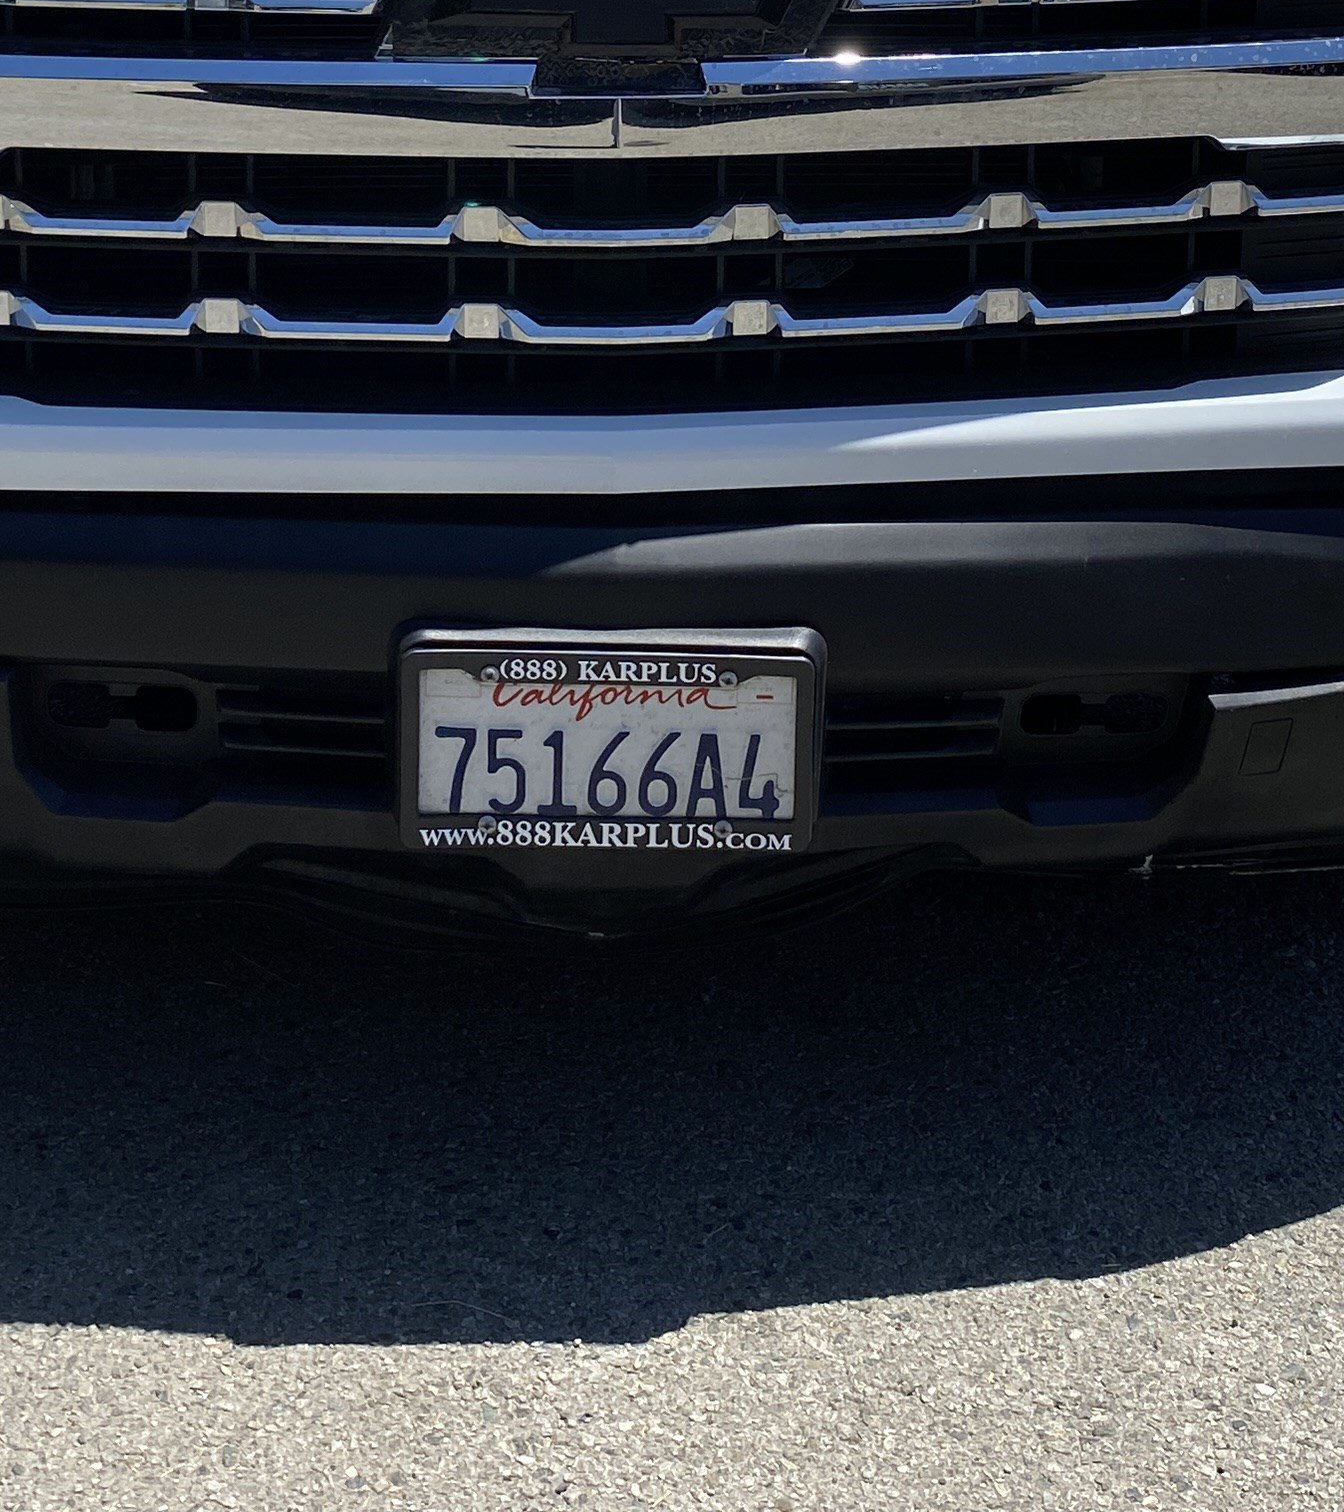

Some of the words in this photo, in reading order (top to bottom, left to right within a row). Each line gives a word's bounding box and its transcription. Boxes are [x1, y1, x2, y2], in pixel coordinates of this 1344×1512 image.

[499, 659, 568, 680] (888)
[578, 660, 717, 683] KARPLUS
[492, 681, 737, 722] California
[435, 725, 780, 818] 75166A4
